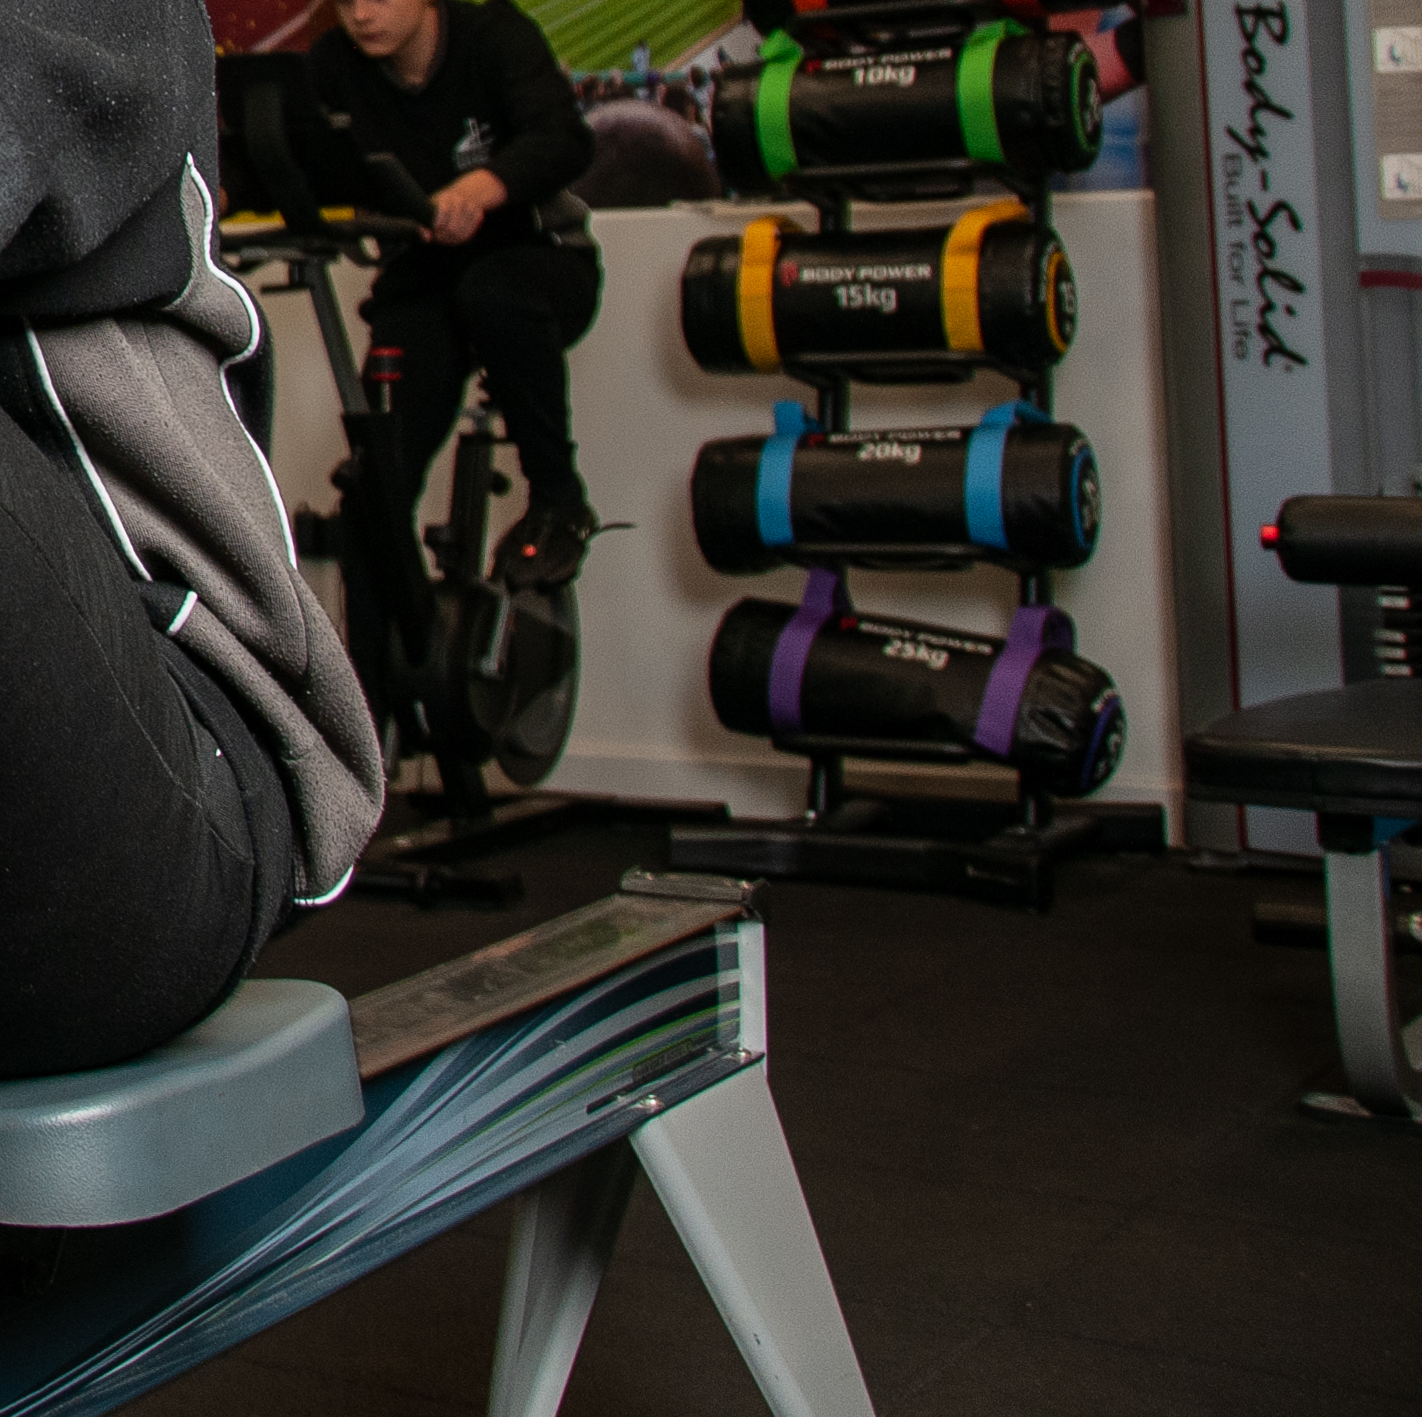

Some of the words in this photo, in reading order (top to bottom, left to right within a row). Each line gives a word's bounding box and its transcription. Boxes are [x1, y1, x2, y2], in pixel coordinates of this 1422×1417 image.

[854, 64, 917, 87] 10kg
[1222, 153, 1244, 229] Built
[1225, 0, 1310, 368] Body-Solid
[799, 266, 857, 282] BODY
[858, 264, 933, 280] POWER
[1227, 242, 1248, 285] for
[833, 283, 898, 315] 15kg
[1230, 299, 1251, 362] Life
[858, 442, 922, 465] 20kg
[882, 638, 950, 671] 25kg
